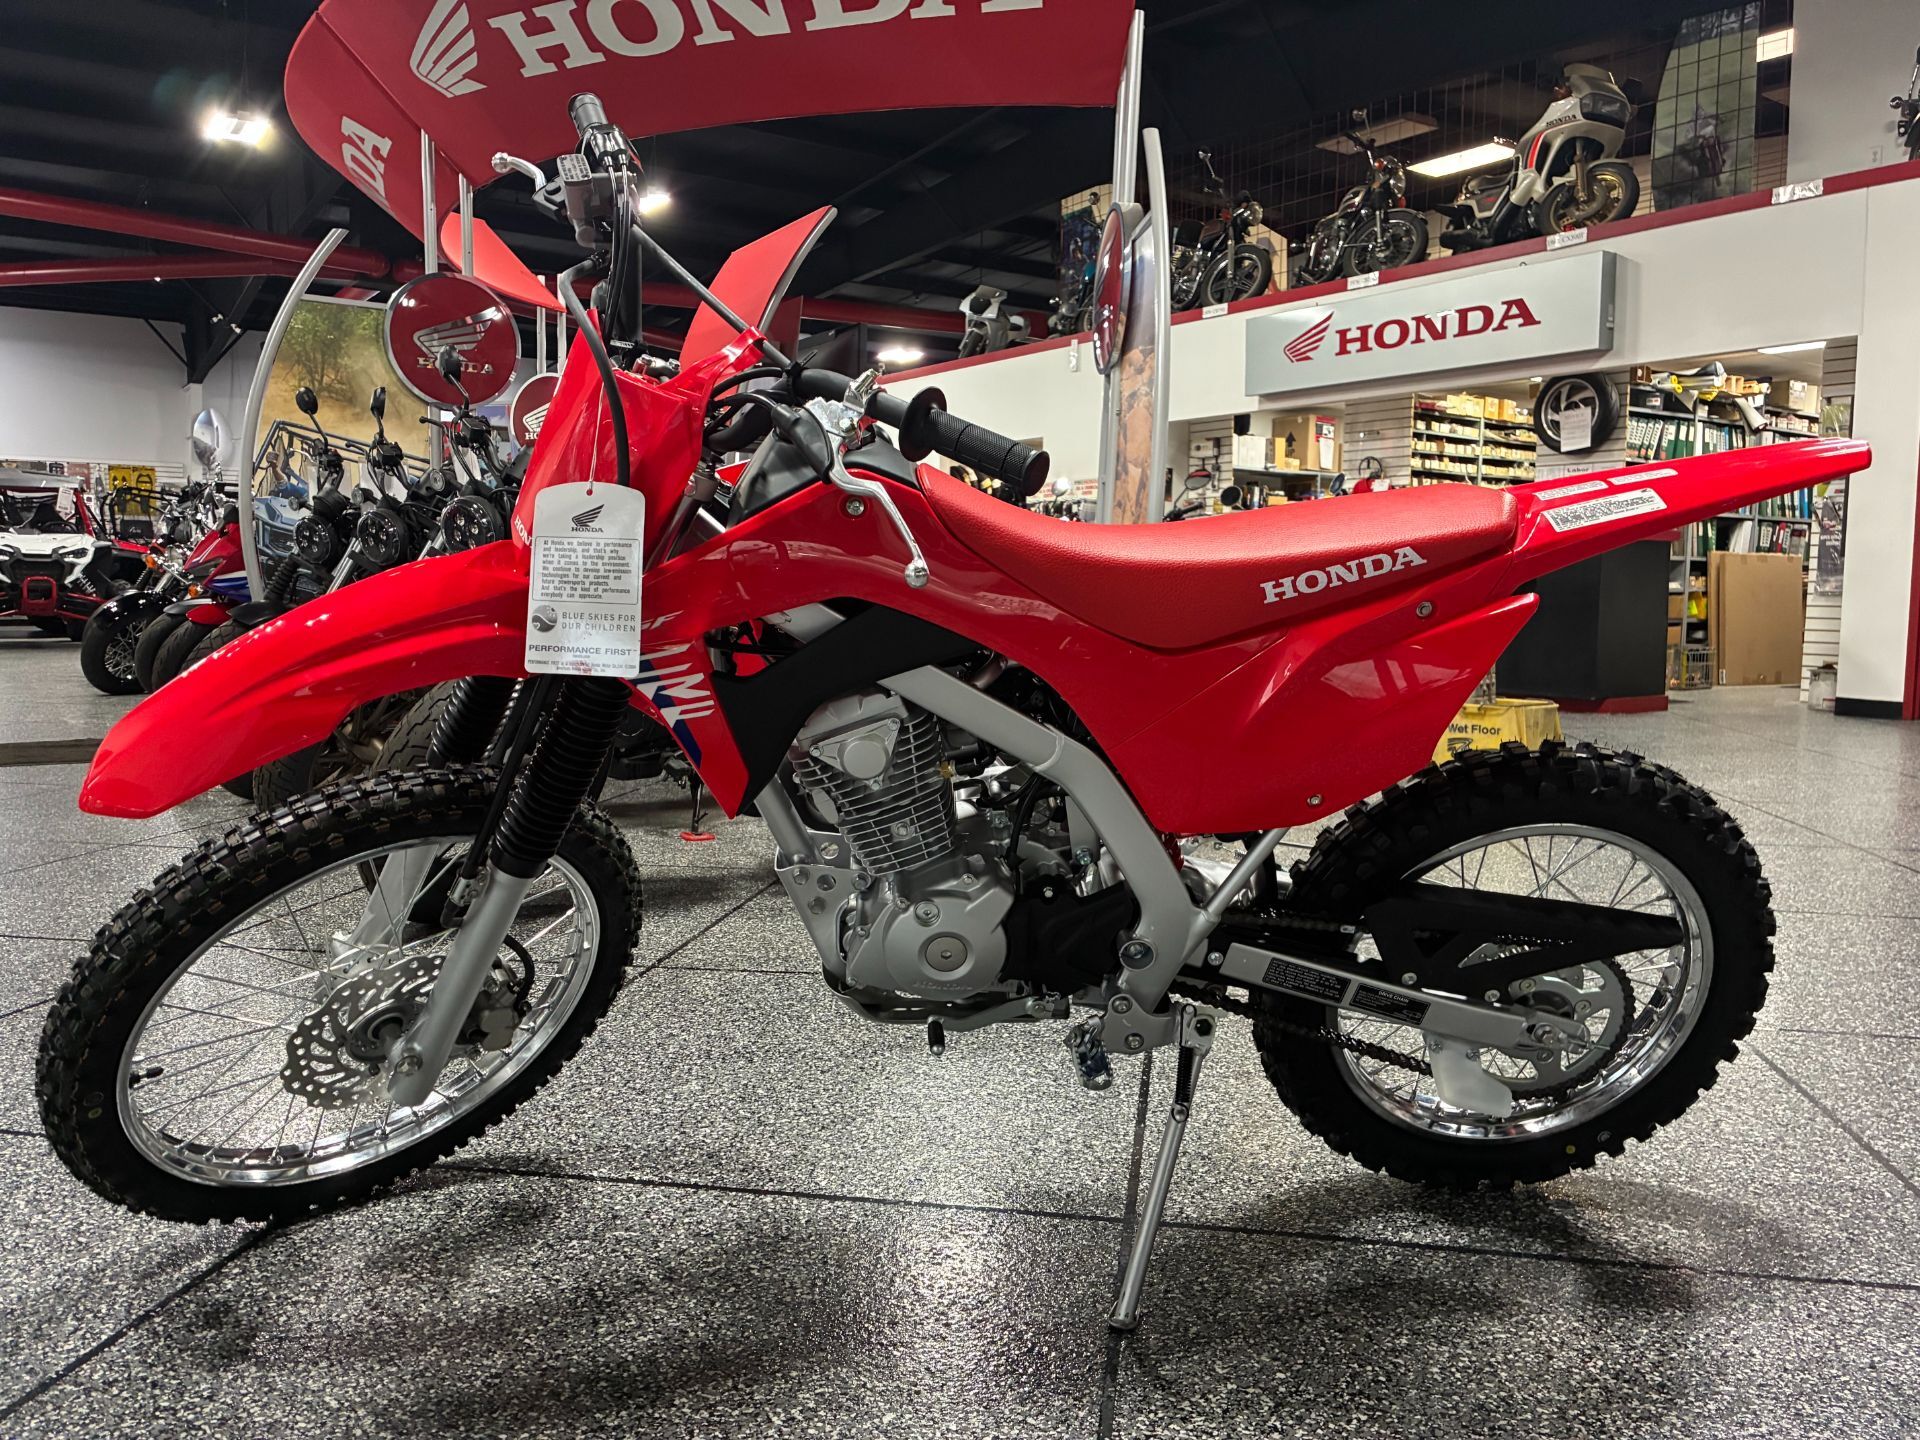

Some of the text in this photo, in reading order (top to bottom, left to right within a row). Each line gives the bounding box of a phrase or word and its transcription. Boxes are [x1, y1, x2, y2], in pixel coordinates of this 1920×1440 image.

[487, 0, 1043, 78] HON
[1546, 114, 1577, 127] HONDA
[1334, 297, 1542, 357] HONDA
[514, 514, 533, 549] HON
[1260, 546, 1427, 604] HONDA
[562, 611, 585, 620] BLUE
[588, 613, 615, 621] SKIES
[618, 614, 636, 622] FOR
[562, 622, 636, 632] OUR CHILDREN
[529, 644, 601, 655] PERFORMANCE
[1448, 724, 1501, 736] Wet Floor
